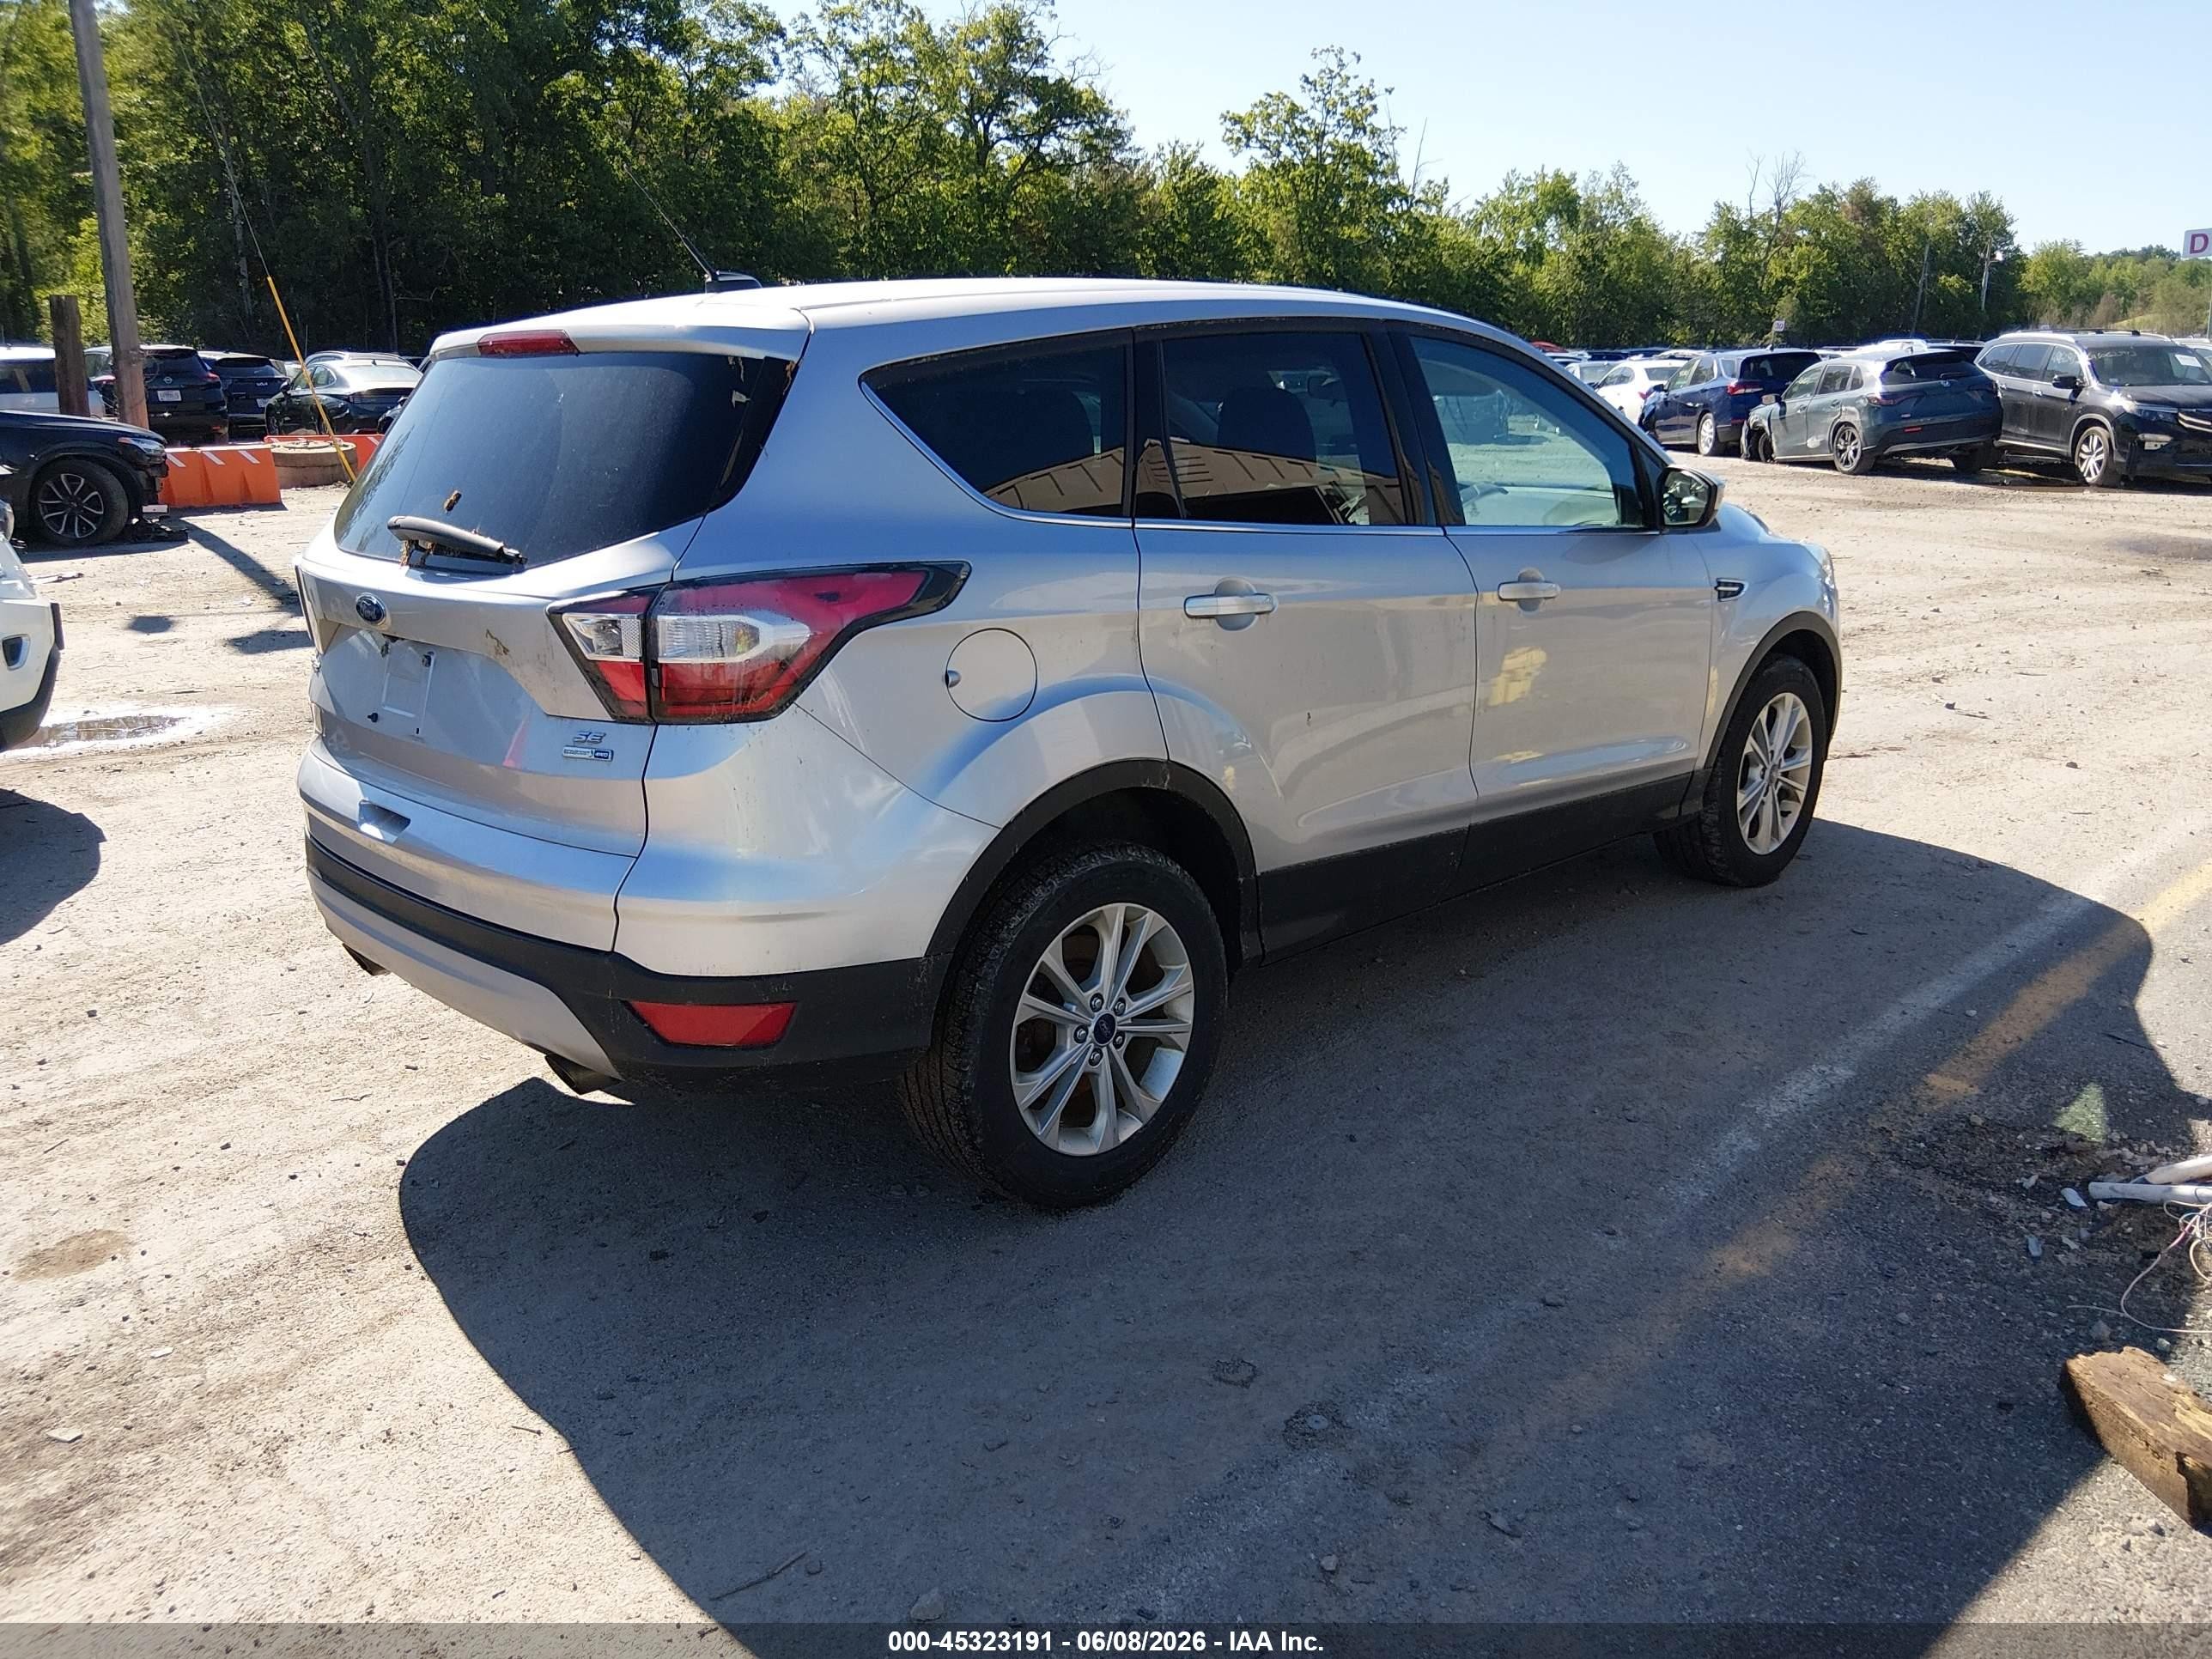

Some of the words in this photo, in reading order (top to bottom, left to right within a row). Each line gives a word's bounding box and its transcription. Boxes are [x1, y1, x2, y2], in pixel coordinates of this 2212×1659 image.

[2190, 233, 2209, 255] D
[360, 599, 379, 620] Ford
[573, 731, 606, 744] SE
